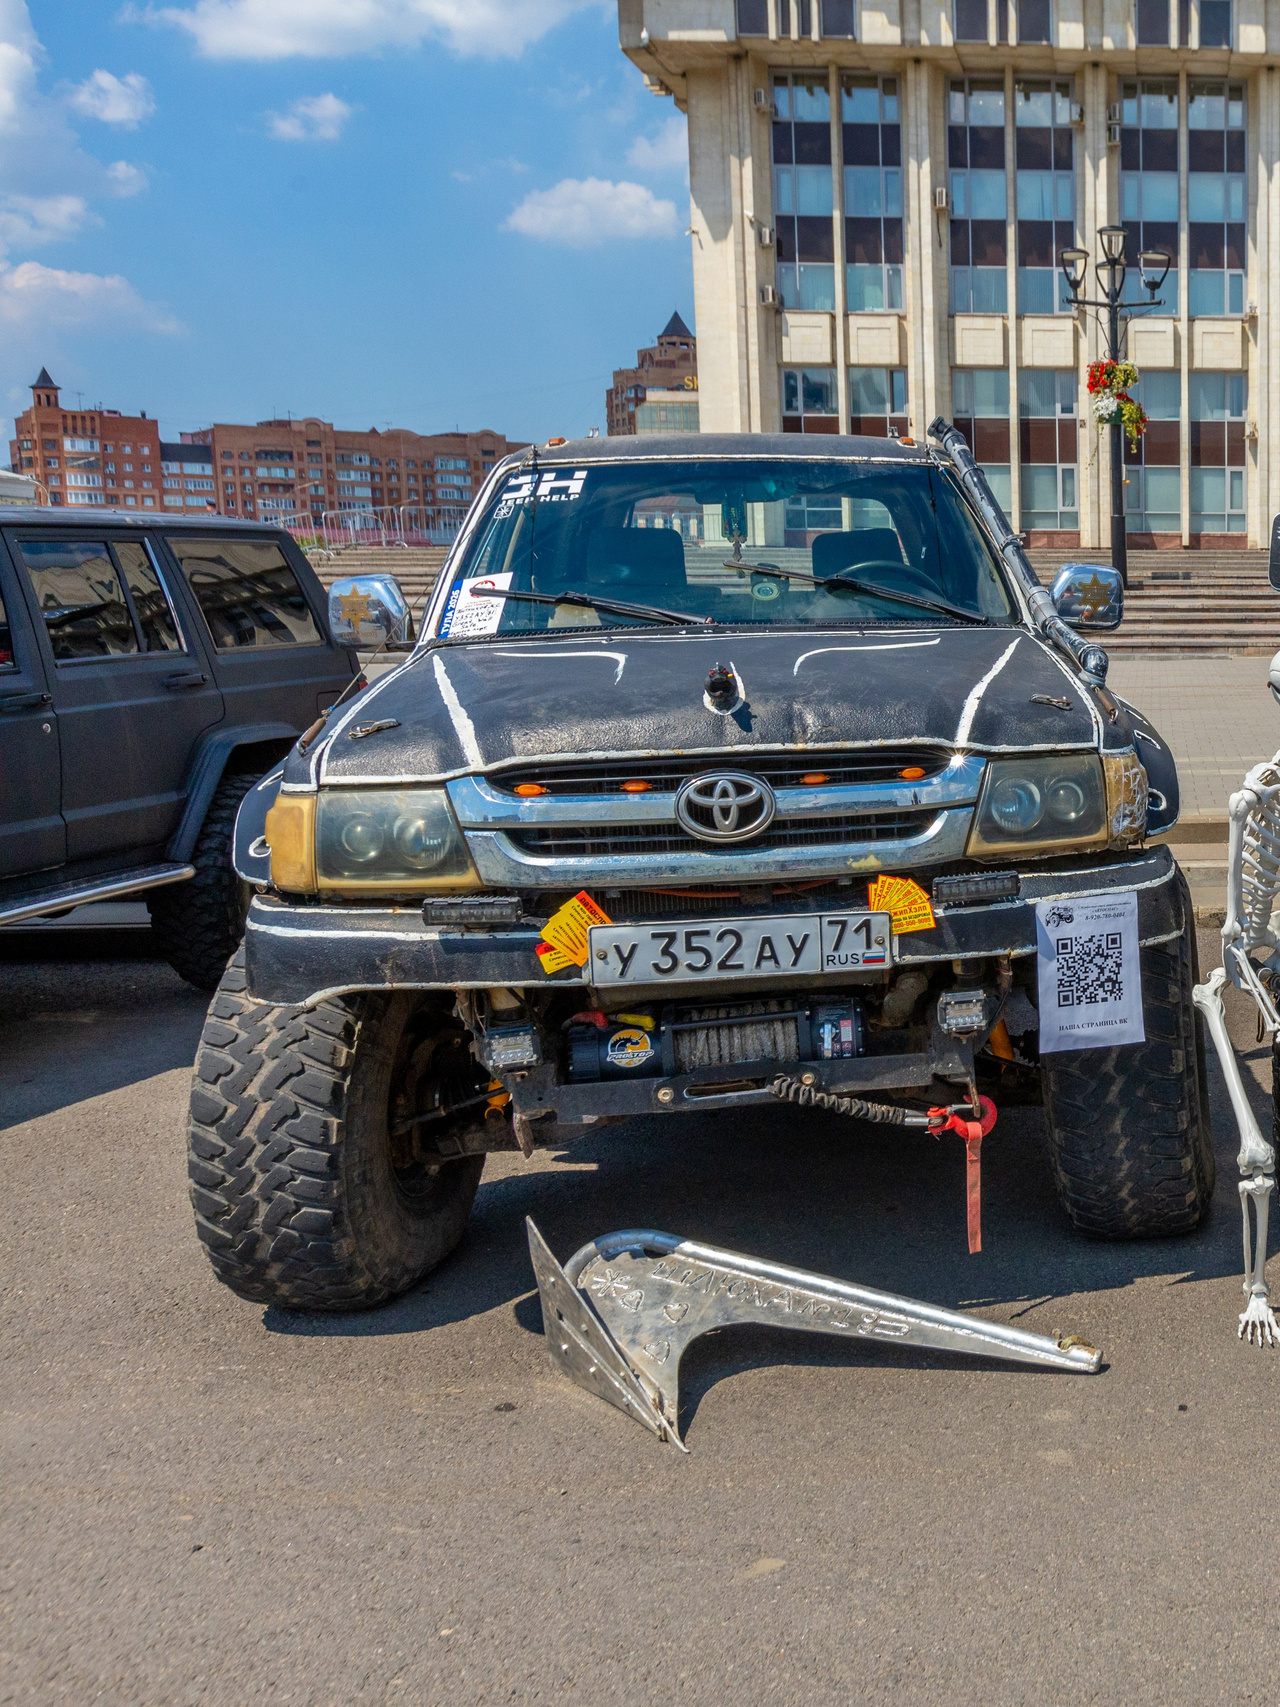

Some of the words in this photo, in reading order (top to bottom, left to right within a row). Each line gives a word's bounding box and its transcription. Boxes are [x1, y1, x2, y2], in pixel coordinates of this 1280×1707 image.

[502, 496, 534, 506] JEEP
[540, 494, 579, 502] HELP
[440, 610, 454, 635] ТУЛА
[447, 589, 460, 611] 2026
[826, 917, 873, 952] 71
[826, 953, 860, 966] RUS
[1081, 1019, 1118, 1029] СТРАНИЦА
